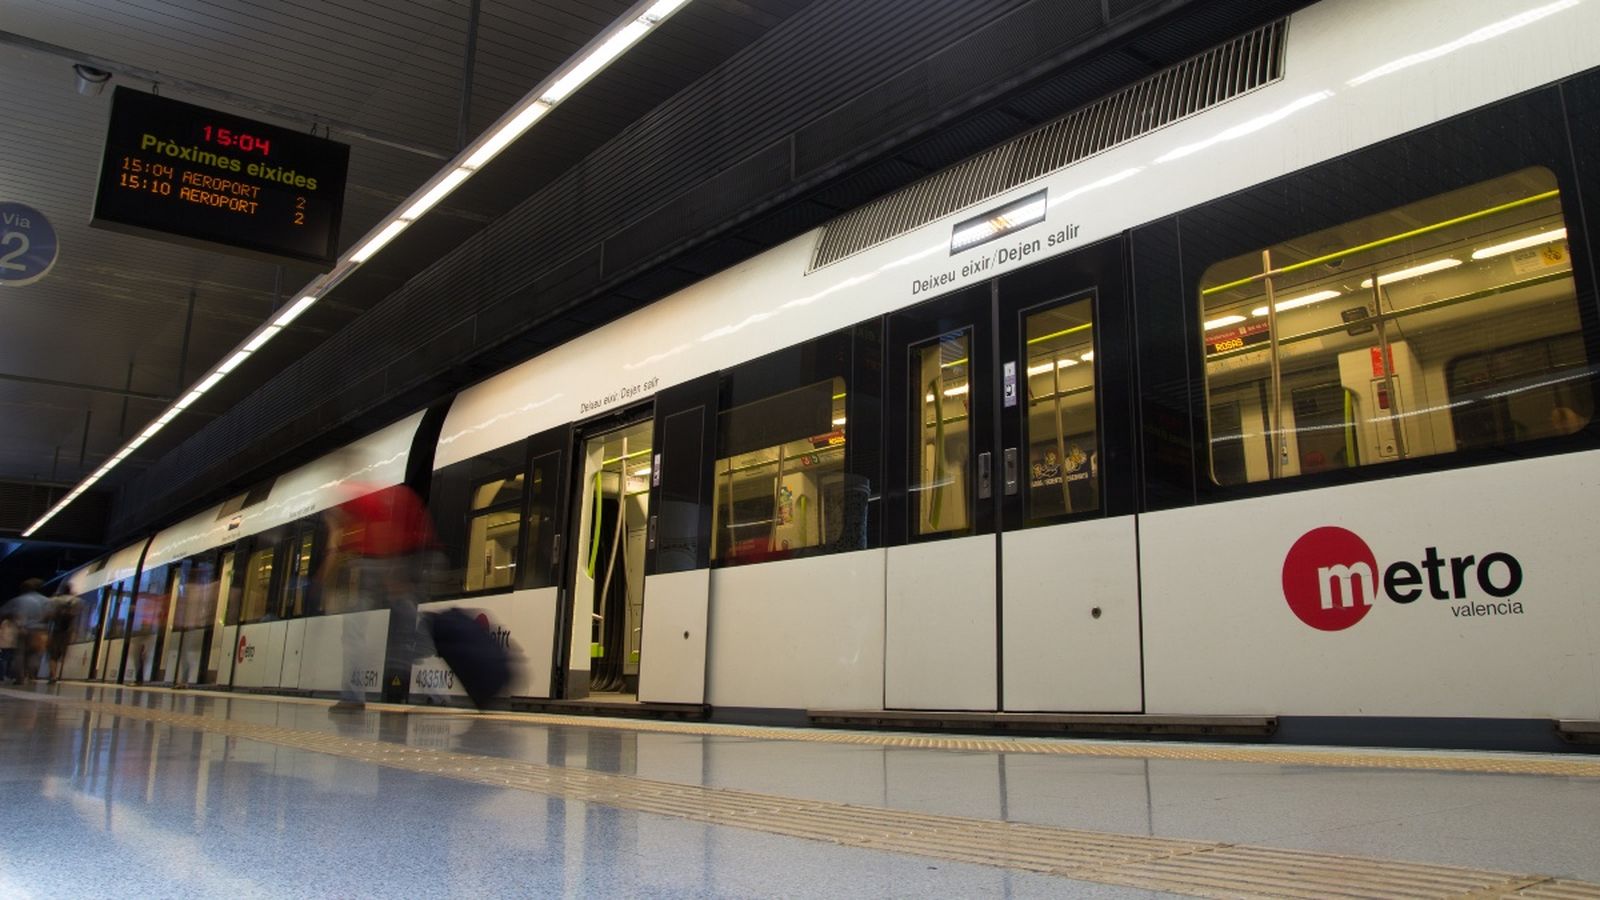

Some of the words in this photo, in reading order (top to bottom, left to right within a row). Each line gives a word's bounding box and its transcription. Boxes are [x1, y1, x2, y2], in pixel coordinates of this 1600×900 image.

[141, 133, 242, 172] Pròximes
[247, 162, 318, 190] eixides
[203, 125, 271, 156] 15:04
[120, 173, 171, 196] 15:10
[180, 187, 258, 215] AEROPORT
[294, 212, 304, 225] 2
[122, 156, 174, 179] 15:04
[182, 171, 261, 198] AEROPORT
[296, 196, 306, 210] 2
[3, 212, 31, 228] Via
[0, 231, 30, 272] 2
[912, 268, 956, 295] Deixeu
[1047, 223, 1080, 247] salir
[1215, 338, 1244, 352] ROSAS
[1317, 546, 1523, 610] metro
[1451, 598, 1524, 617] valencia
